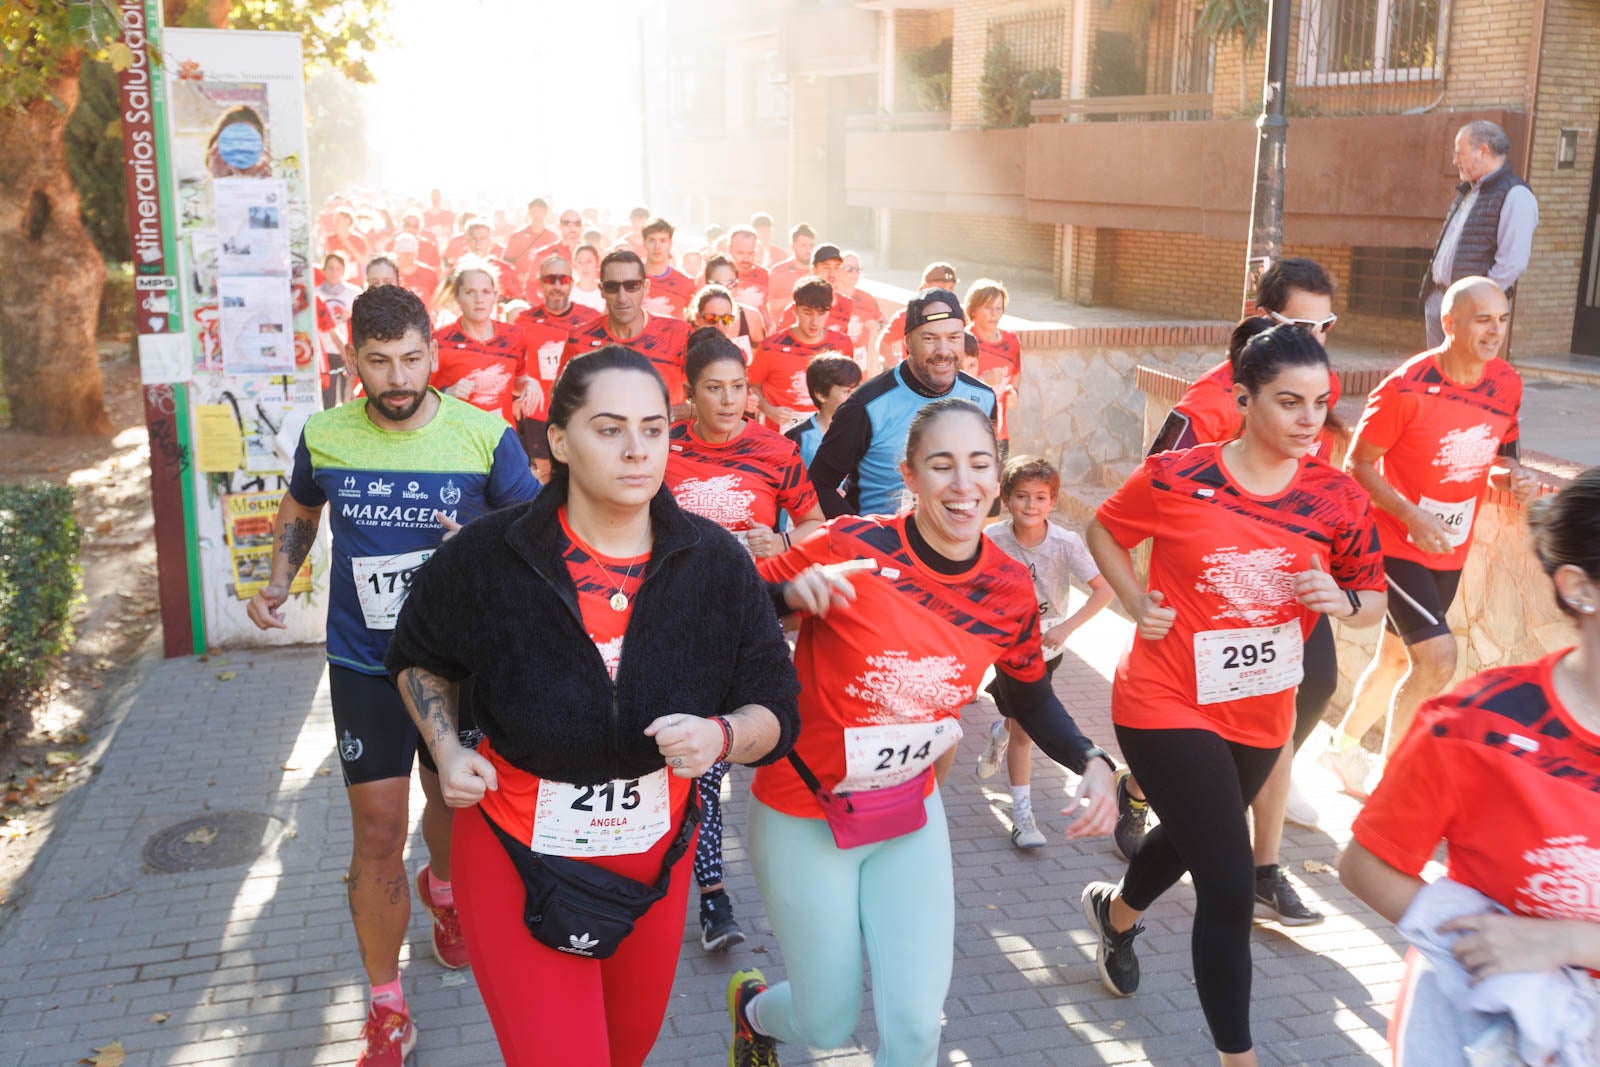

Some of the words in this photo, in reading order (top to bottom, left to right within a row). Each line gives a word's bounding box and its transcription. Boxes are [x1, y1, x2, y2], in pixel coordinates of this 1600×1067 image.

[675, 492, 748, 507] carrera
[1222, 641, 1276, 669] 295
[1239, 668, 1268, 678] ESTHER
[875, 741, 931, 771] 214
[570, 779, 641, 812] 215
[590, 817, 627, 827] ÁNGELA
